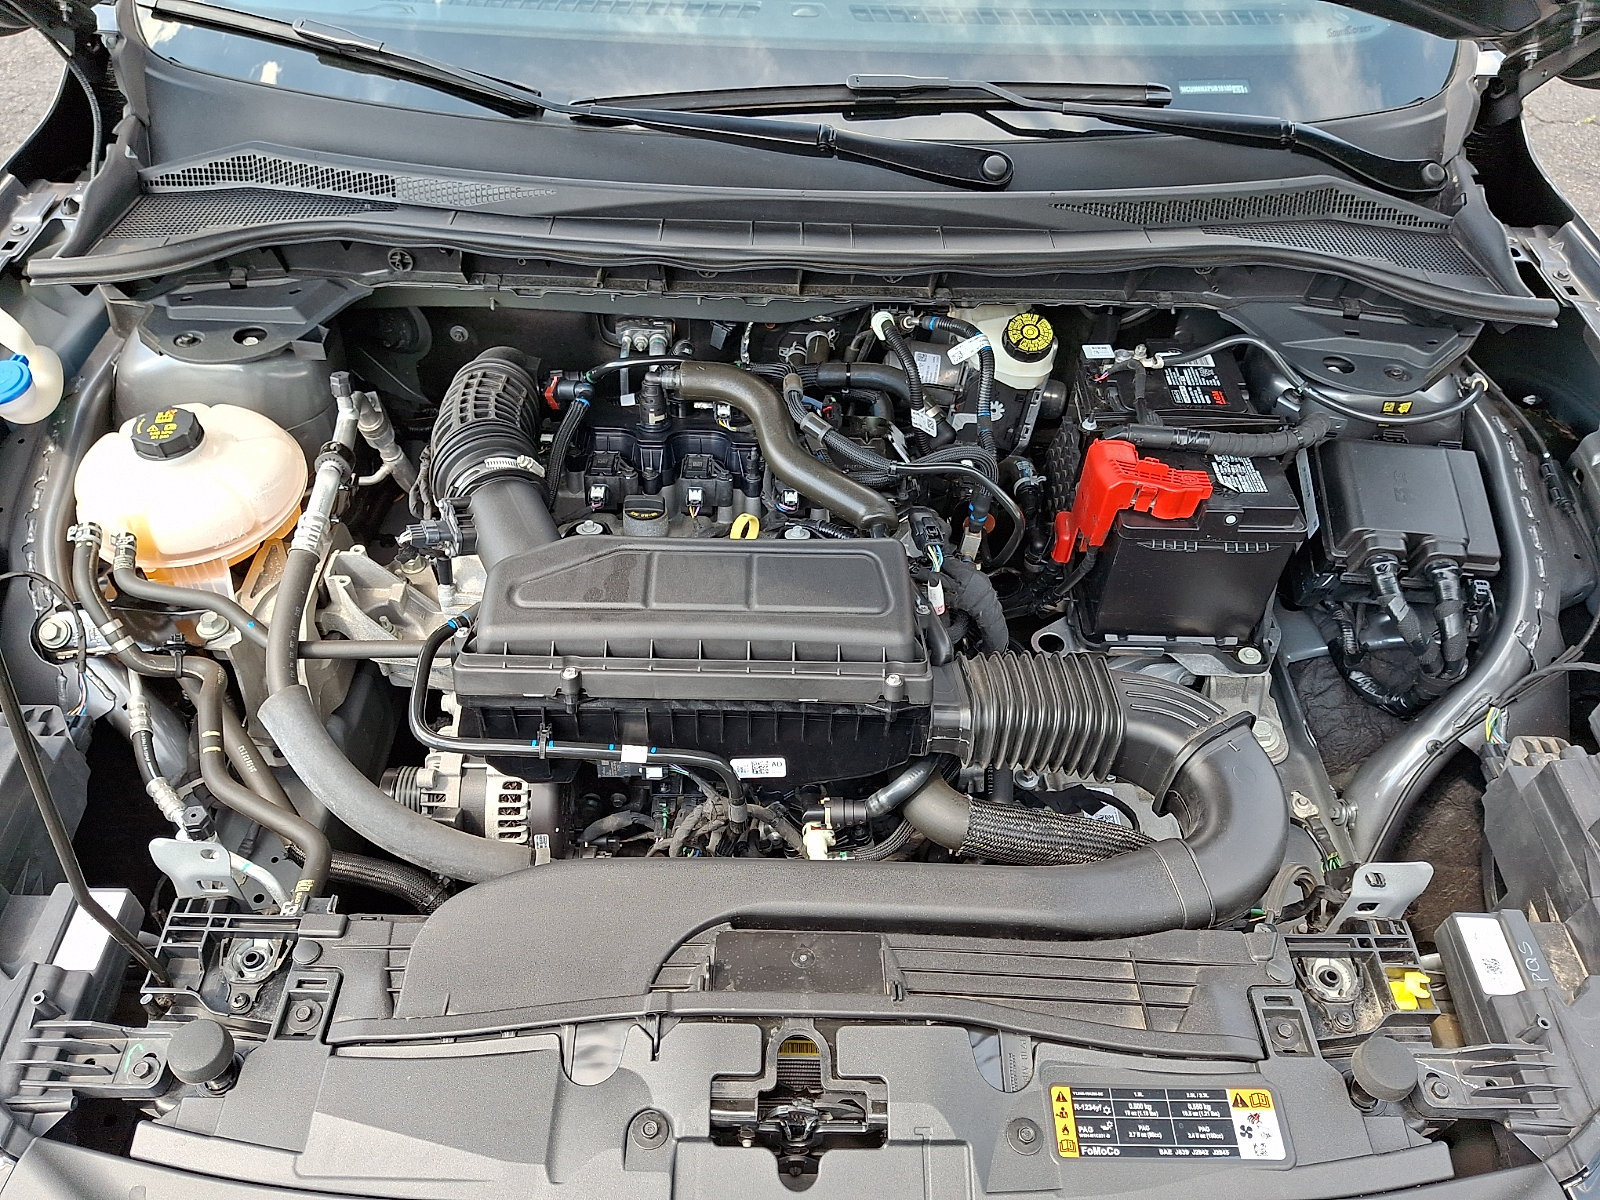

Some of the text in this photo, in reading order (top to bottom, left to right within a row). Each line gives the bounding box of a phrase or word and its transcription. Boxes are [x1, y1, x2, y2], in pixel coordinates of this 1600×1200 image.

[1518, 941, 1549, 982] PQS
[1074, 1103, 1102, 1112] R-1234yf
[1078, 1126, 1094, 1134] PAG
[1081, 1146, 1120, 1156] FoMoCo
